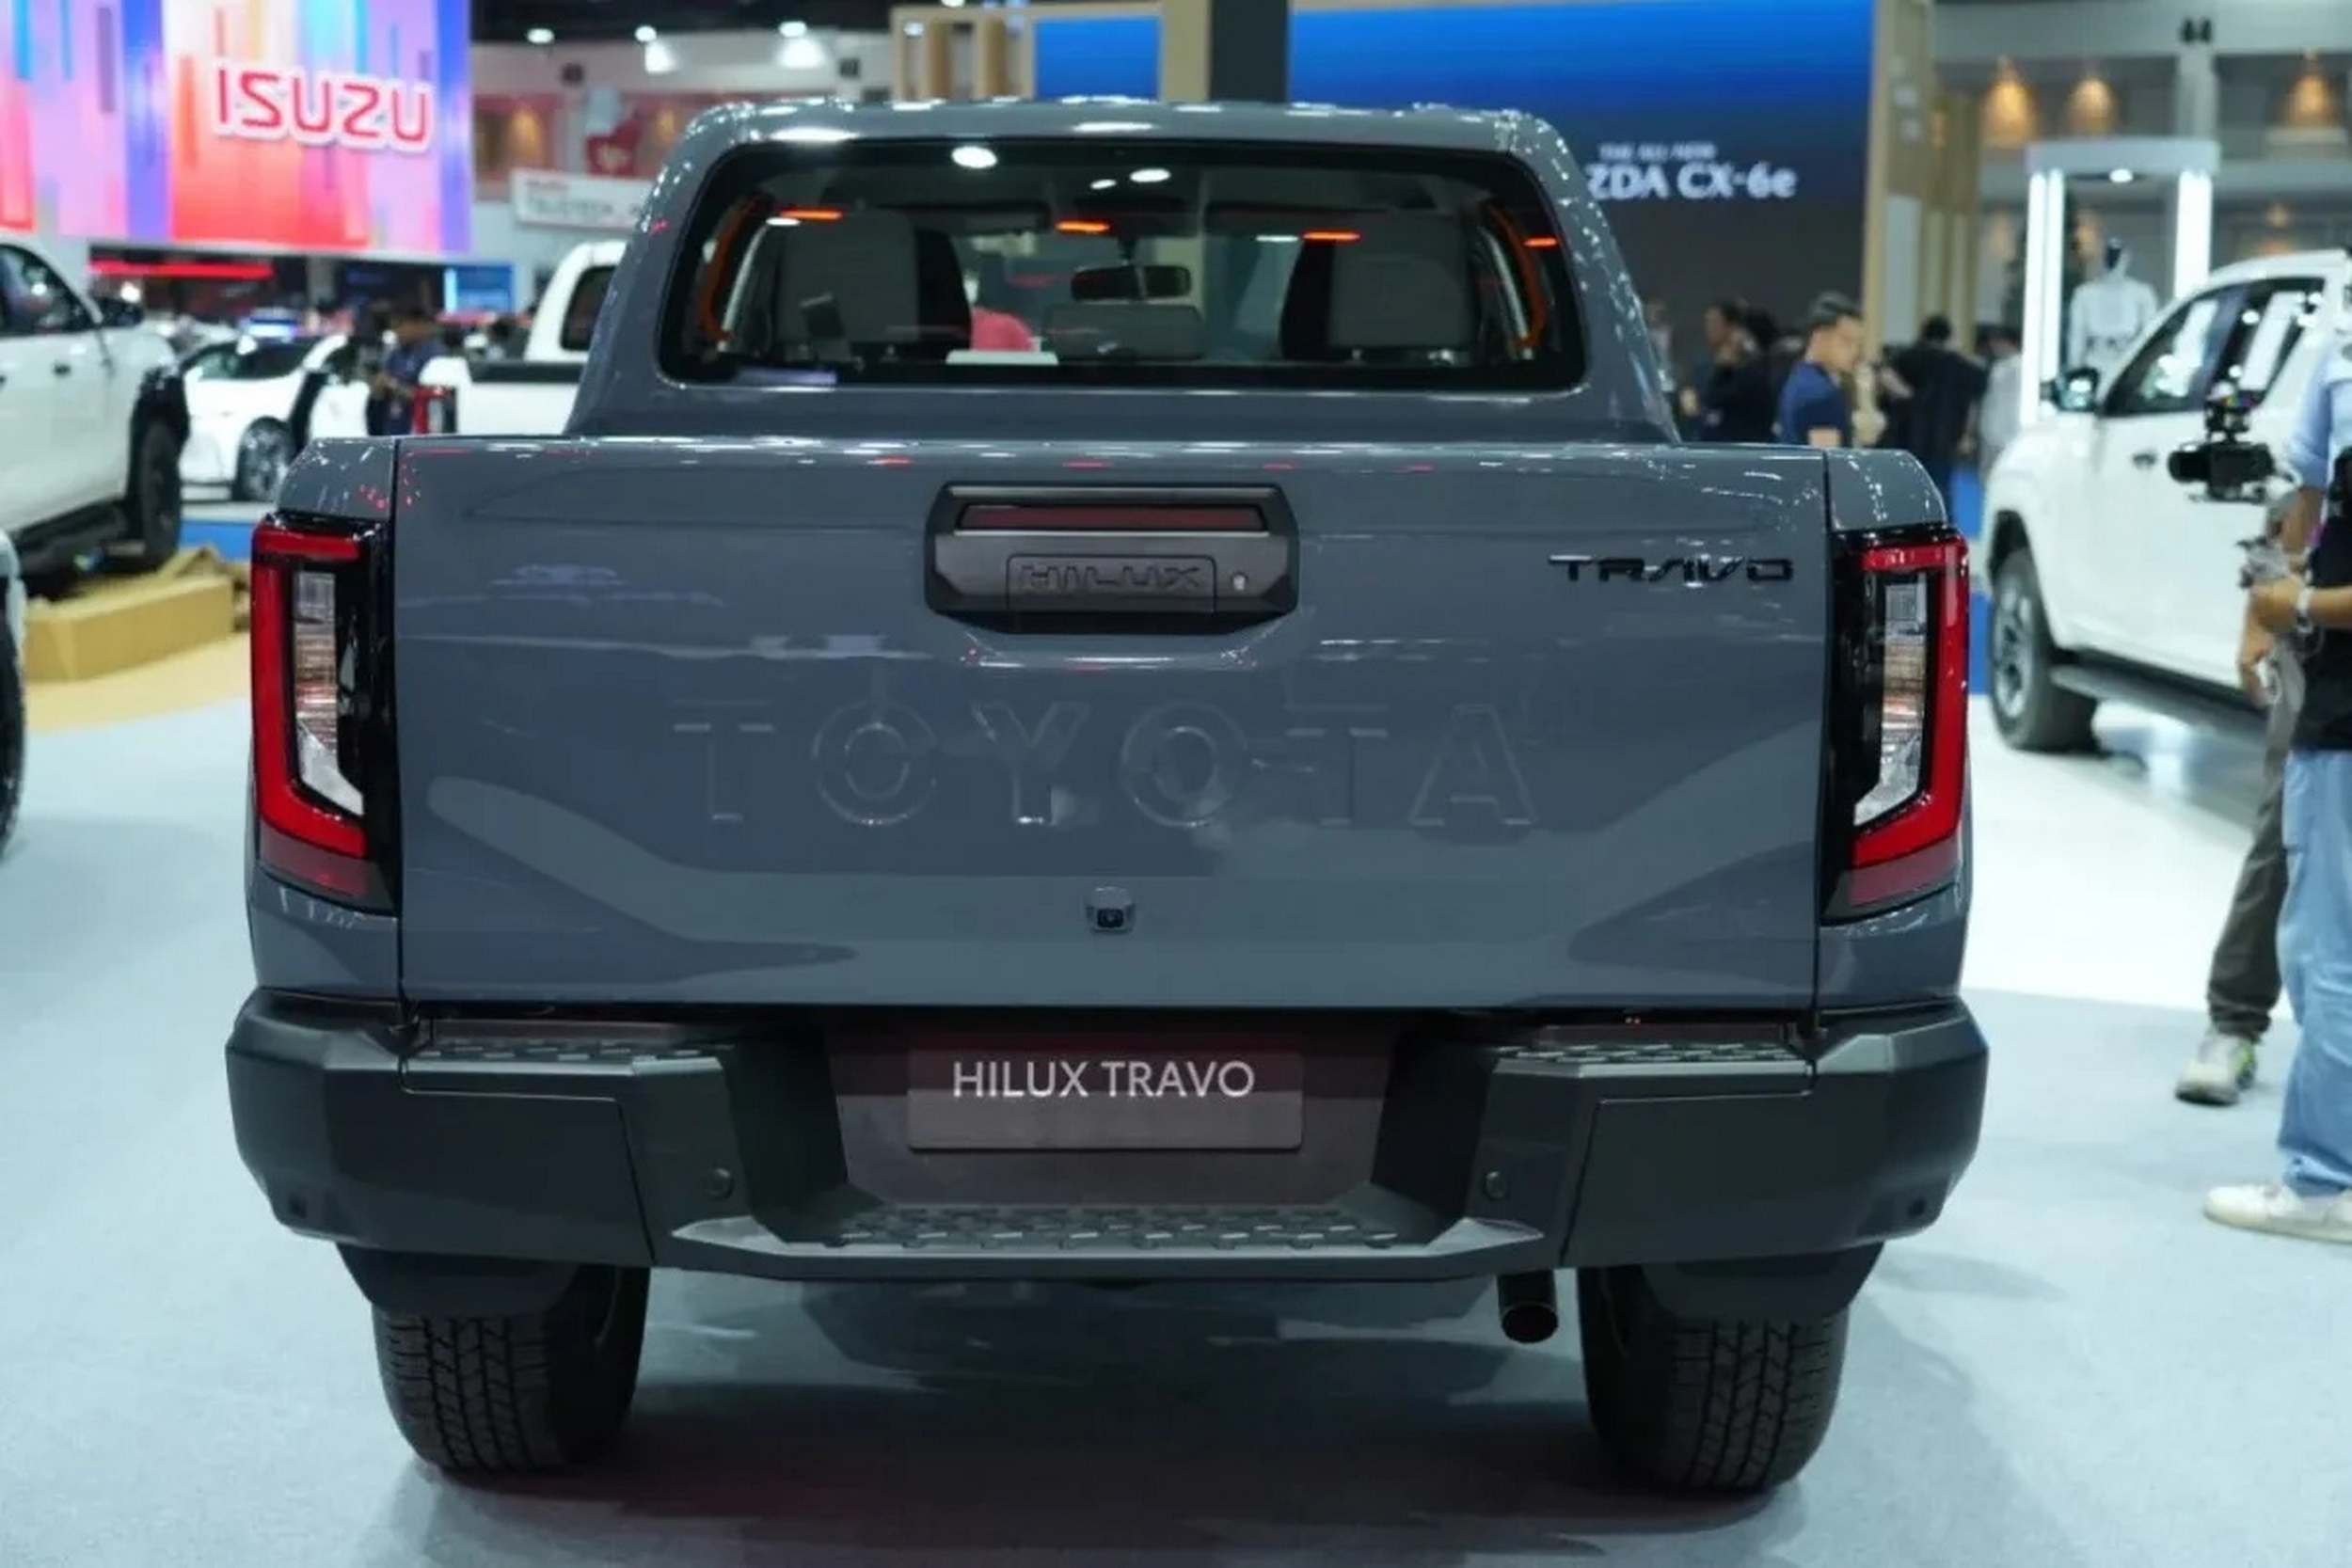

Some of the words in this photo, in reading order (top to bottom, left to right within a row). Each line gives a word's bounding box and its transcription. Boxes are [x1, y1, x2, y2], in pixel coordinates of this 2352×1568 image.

[215, 66, 431, 147] ISUZU
[1586, 163, 1670, 199] ZDA
[1677, 161, 1798, 199] CX-6e
[1020, 565, 1200, 593] HILUX
[1549, 554, 1793, 583] TRAVO
[670, 699, 1539, 829] TOYOTA
[952, 1060, 1089, 1099] HILUX
[1100, 1060, 1256, 1099] TRAVO
